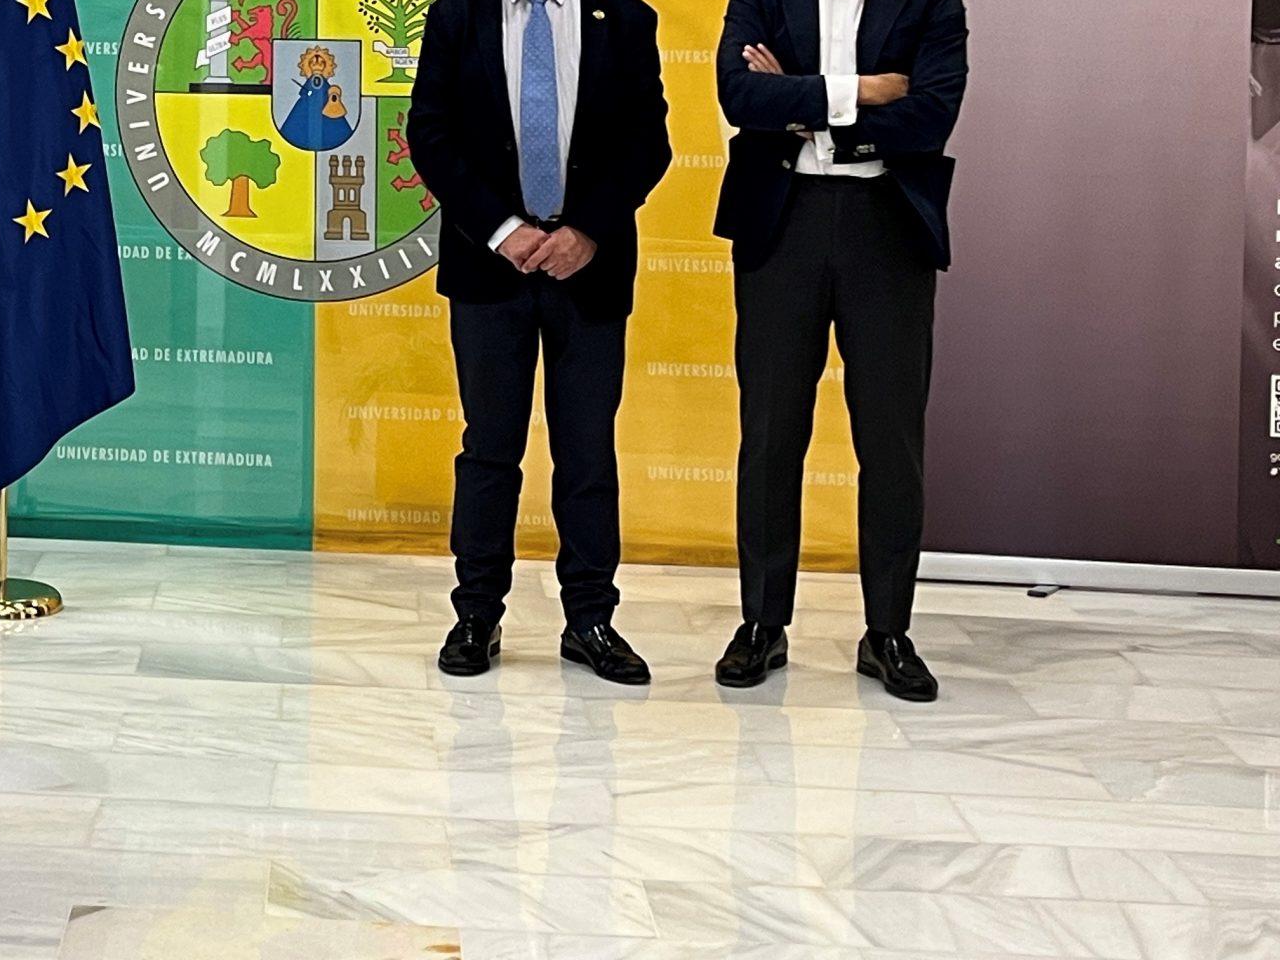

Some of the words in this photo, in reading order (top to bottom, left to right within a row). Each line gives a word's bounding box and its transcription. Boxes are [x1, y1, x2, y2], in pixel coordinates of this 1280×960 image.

[155, 246, 172, 260] DE
[196, 230, 433, 292] MCMLXXIII
[348, 303, 441, 318] UNIVERSIDAD
[154, 348, 170, 361] DE
[176, 349, 273, 364] EXTREMADURA
[348, 406, 441, 420] UNIVERSIDAD
[57, 446, 147, 462] UNIVERSIDAD
[153, 450, 169, 463] DE
[176, 451, 272, 467] EXTREMADURA
[347, 508, 440, 524] UNIVERSIDAD
